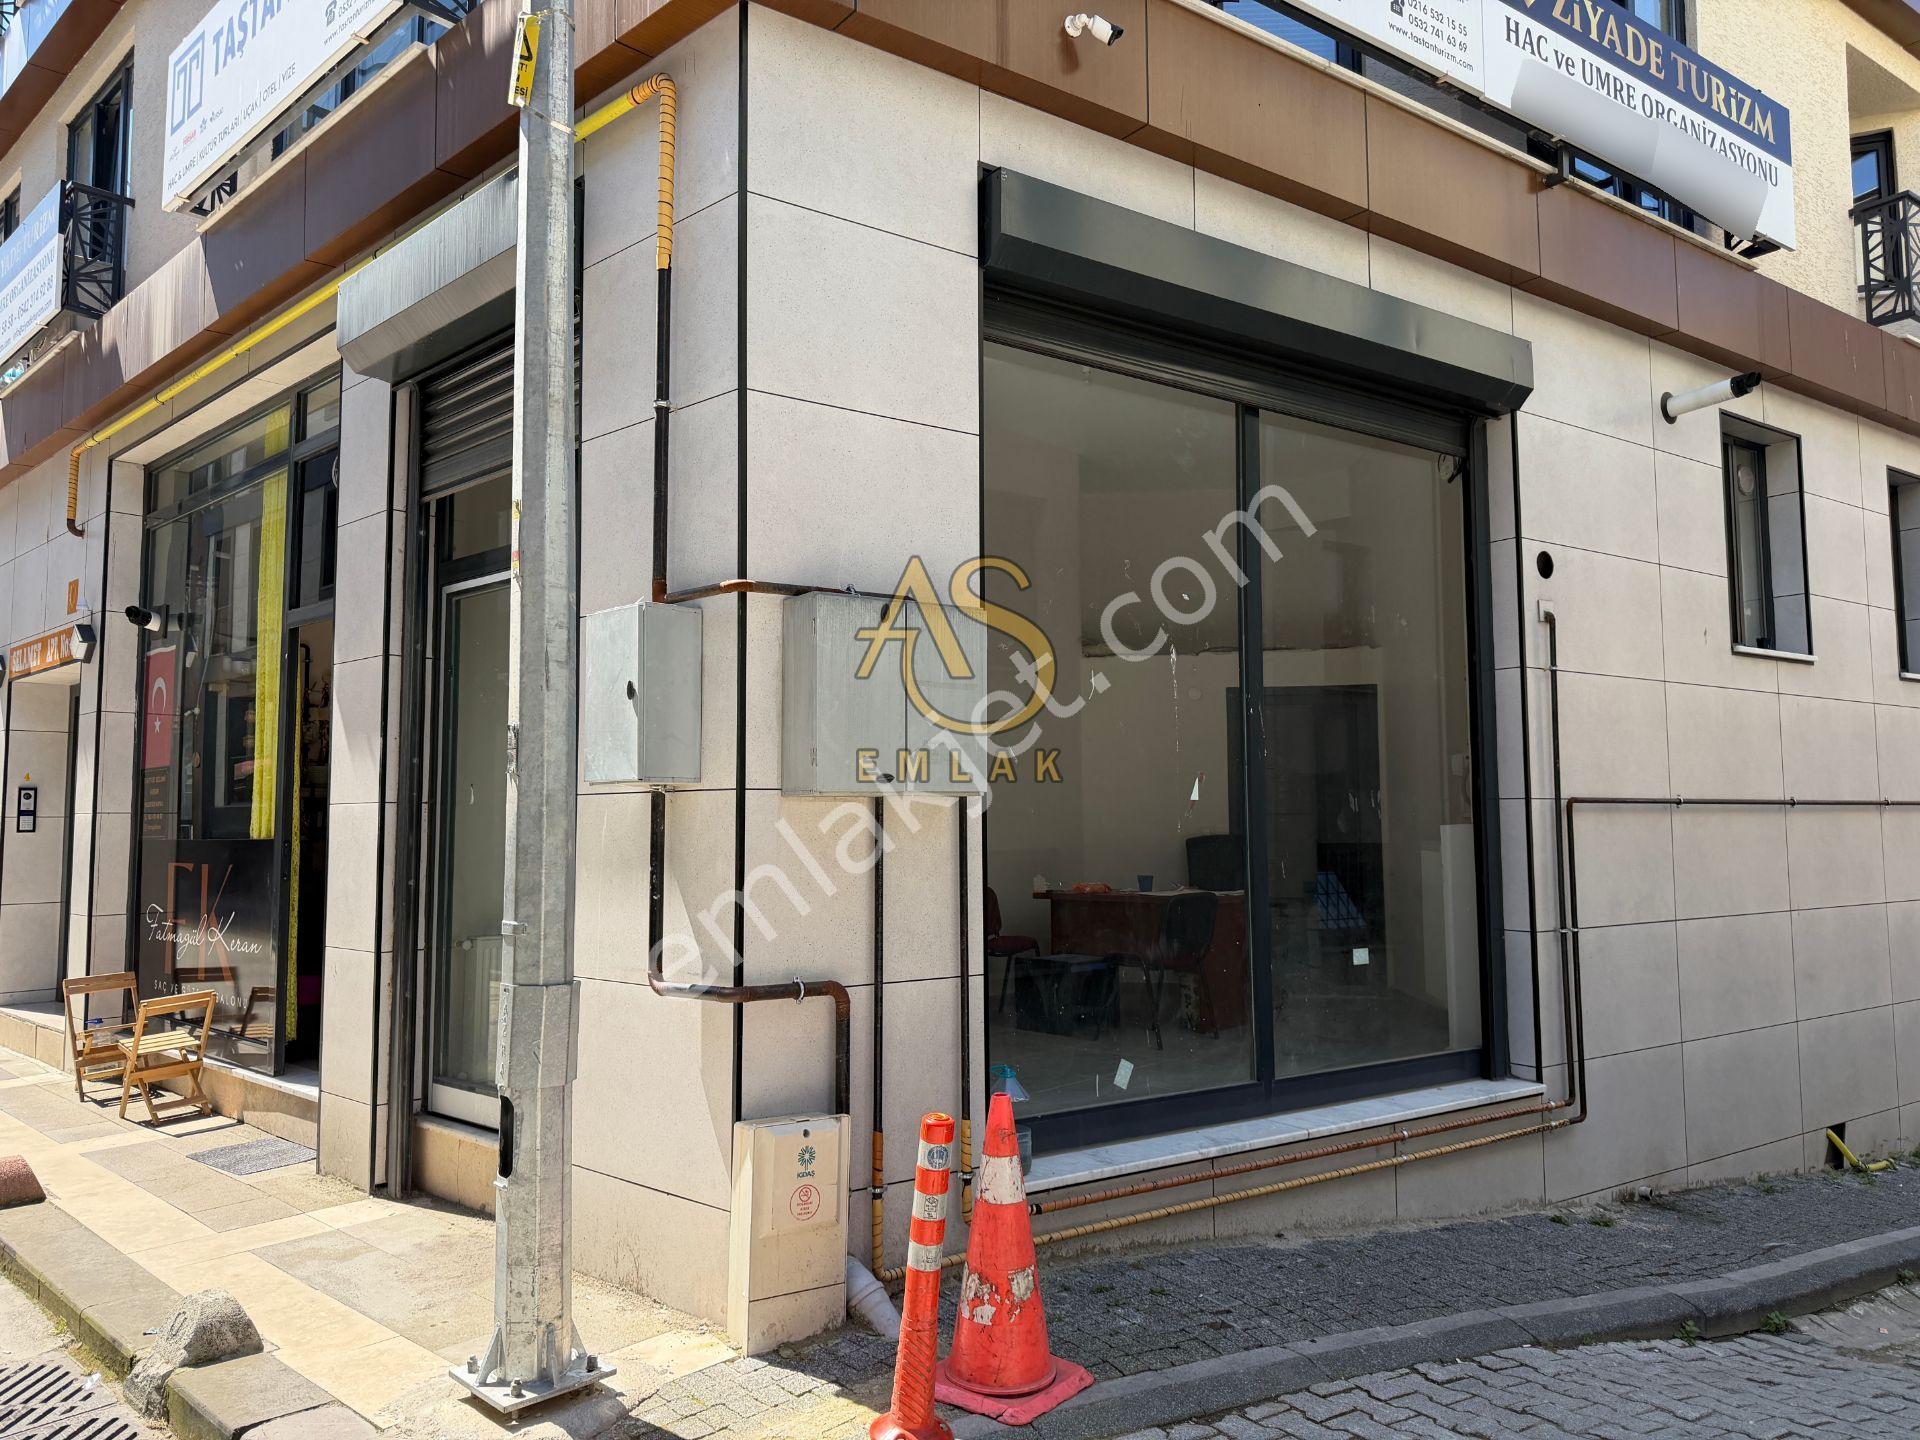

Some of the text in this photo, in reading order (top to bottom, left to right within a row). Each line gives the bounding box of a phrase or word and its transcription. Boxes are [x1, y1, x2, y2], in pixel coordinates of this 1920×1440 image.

[1388, 21, 1474, 72] www.tastanturizm.com
[1408, 13, 1468, 53] 0532 741 63 69
[1430, 8, 1444, 24] 532
[1447, 16, 1456, 30] 15
[1459, 23, 1468, 37] 55
[1505, 15, 1548, 63] HAC
[1553, 49, 1576, 77] ve
[1581, 58, 1637, 110] UMRE
[1670, 52, 1776, 144] TURİZM
[146, 903, 263, 960] Fatmagül Keran
